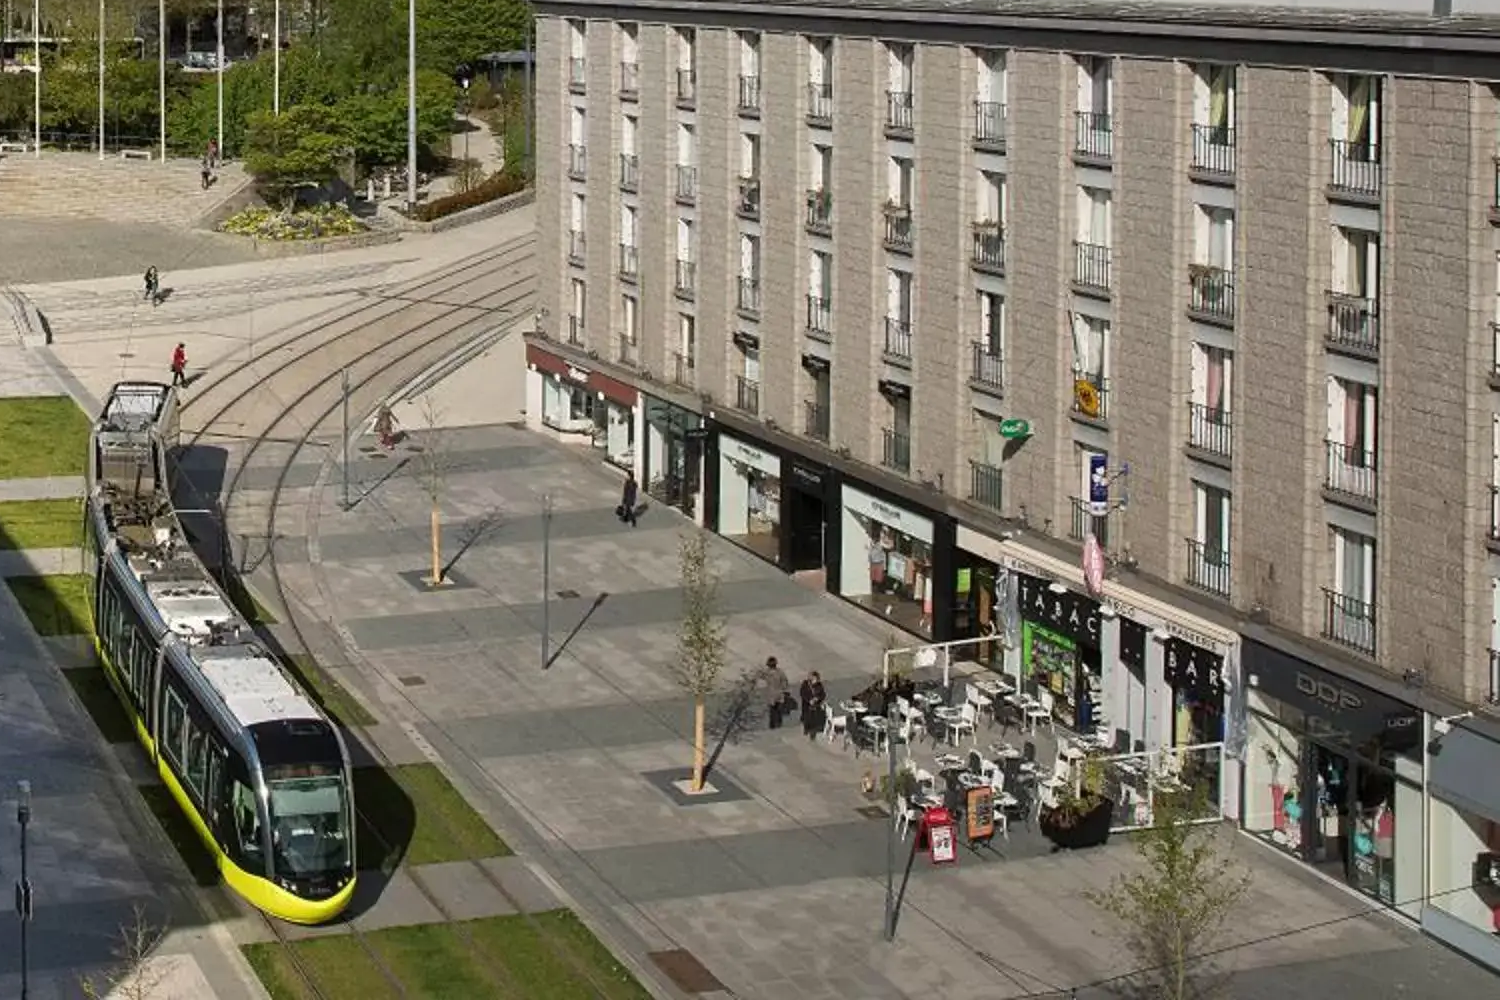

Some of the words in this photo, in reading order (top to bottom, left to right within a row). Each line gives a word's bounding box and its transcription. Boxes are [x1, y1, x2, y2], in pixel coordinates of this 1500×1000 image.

[1022, 587, 1098, 633] TABAC
[1168, 651, 1218, 688] BAR
[1296, 671, 1362, 709] DDP
